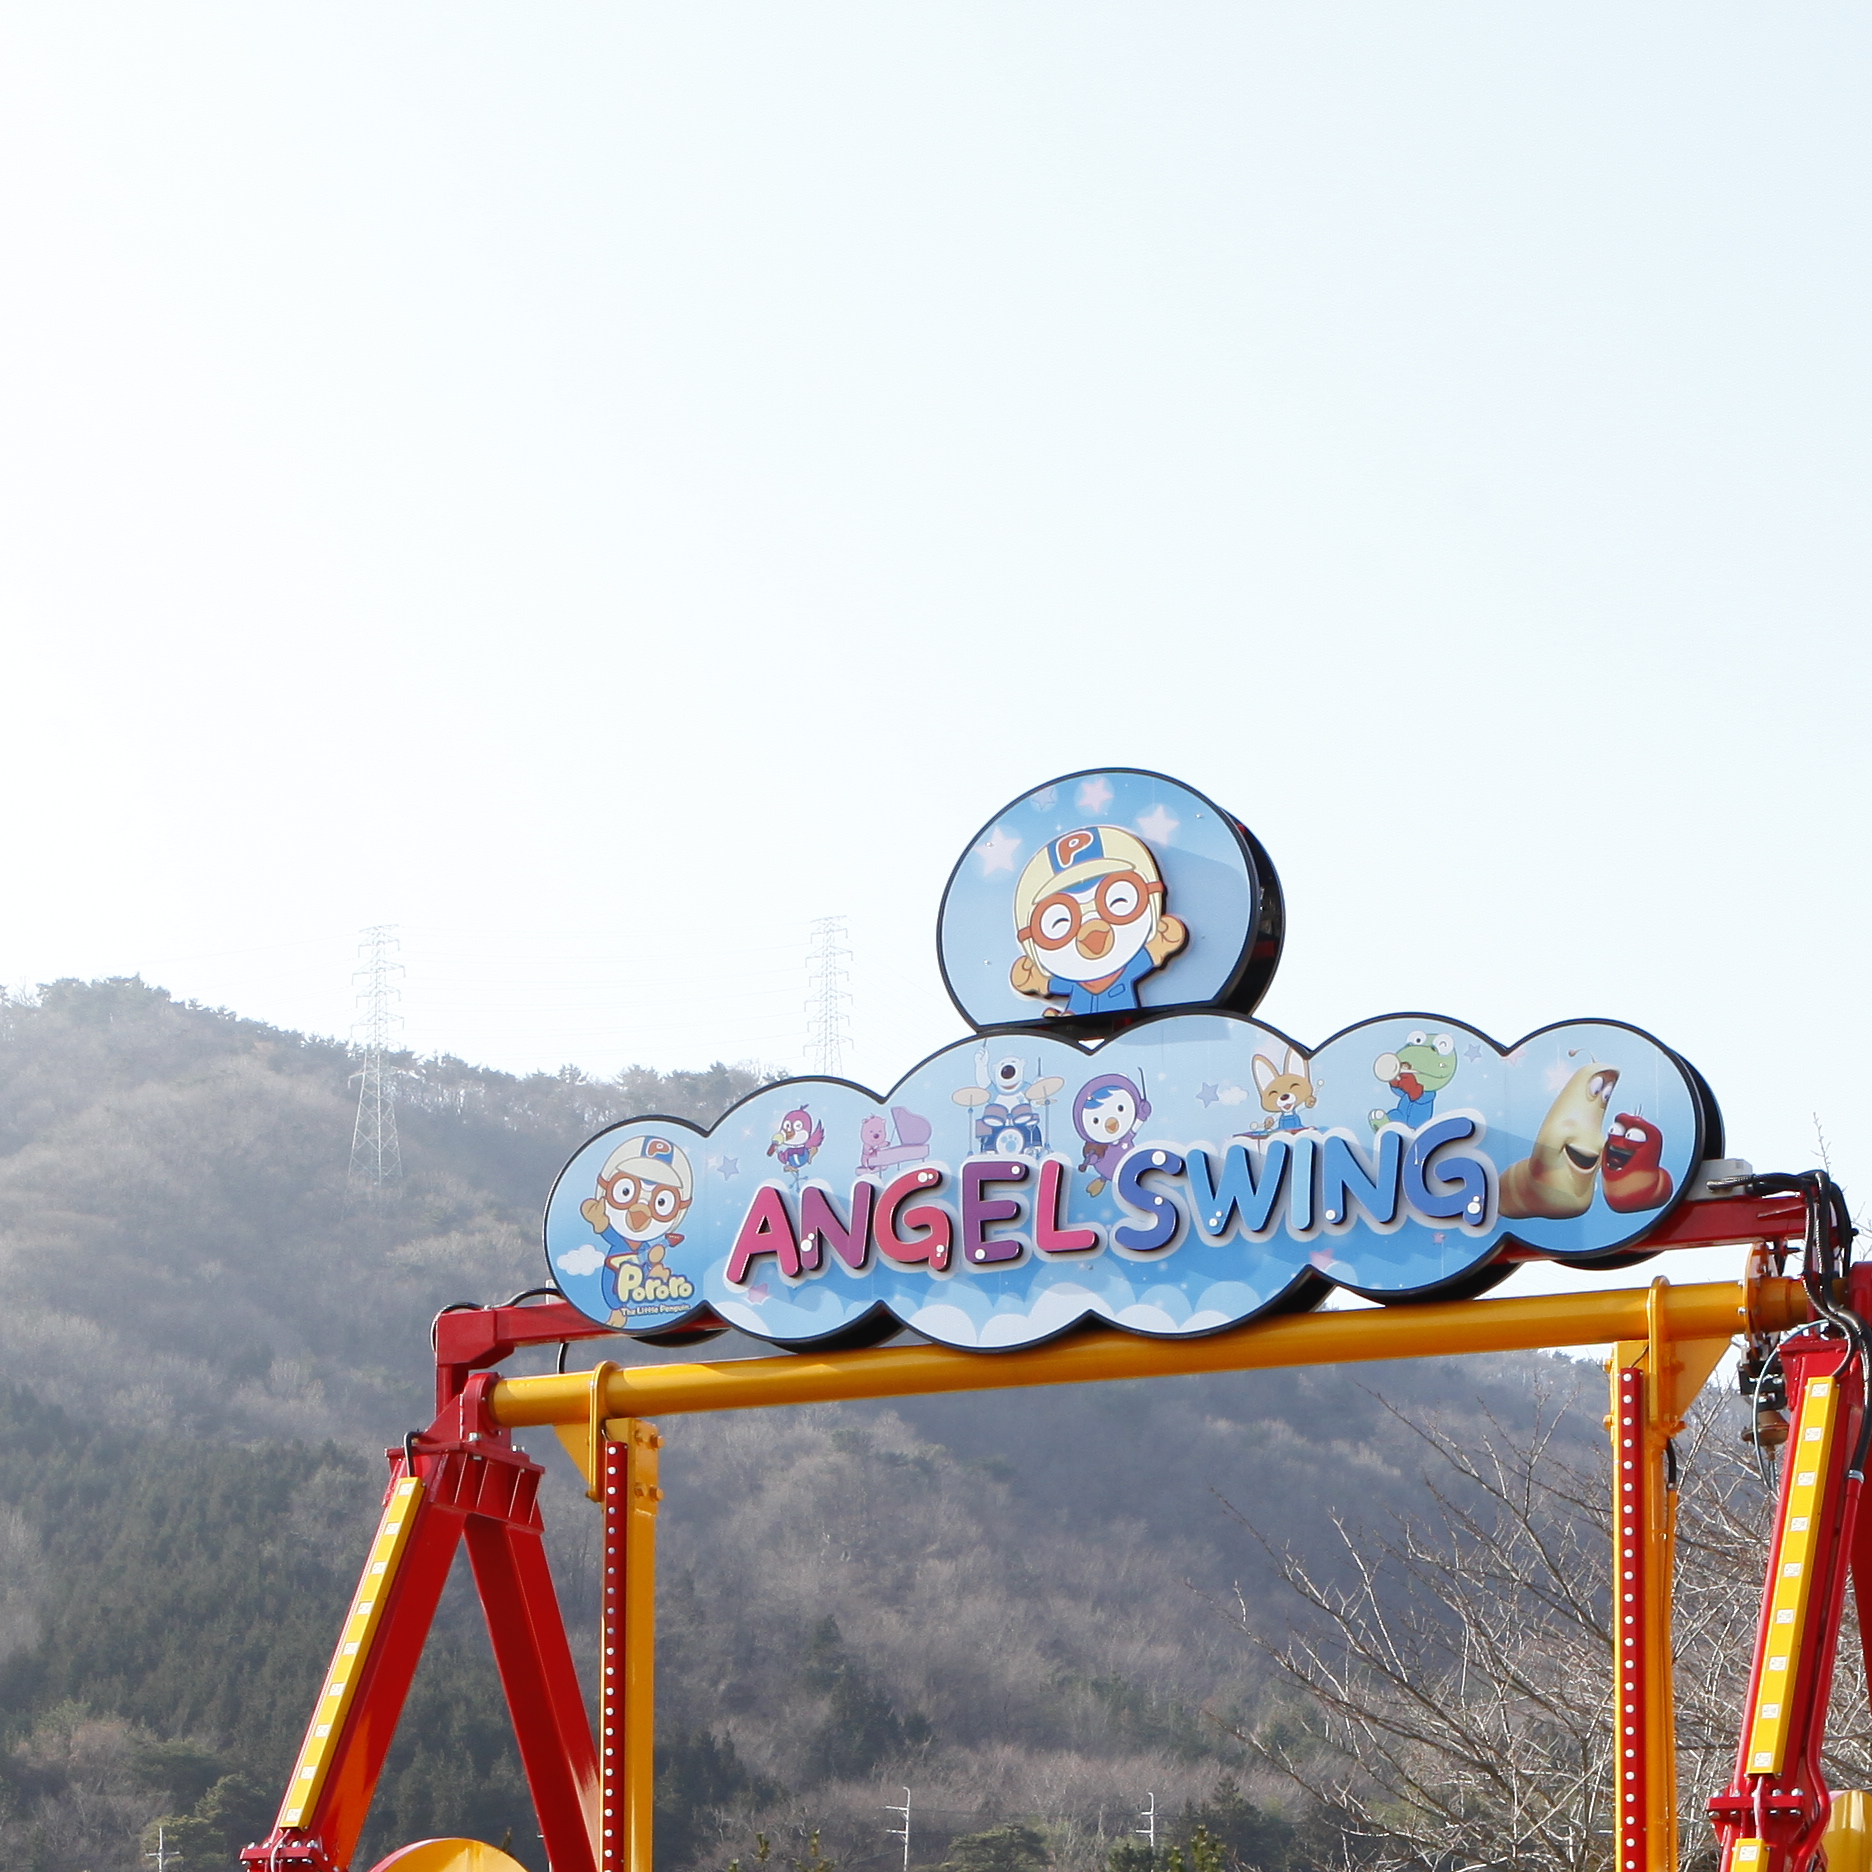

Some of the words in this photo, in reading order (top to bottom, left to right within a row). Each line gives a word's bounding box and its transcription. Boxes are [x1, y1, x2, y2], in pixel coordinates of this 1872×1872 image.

[725, 1159, 1096, 1286] ANGEL
[1114, 1116, 1489, 1252] SWING
[617, 1262, 694, 1303] Pororo
